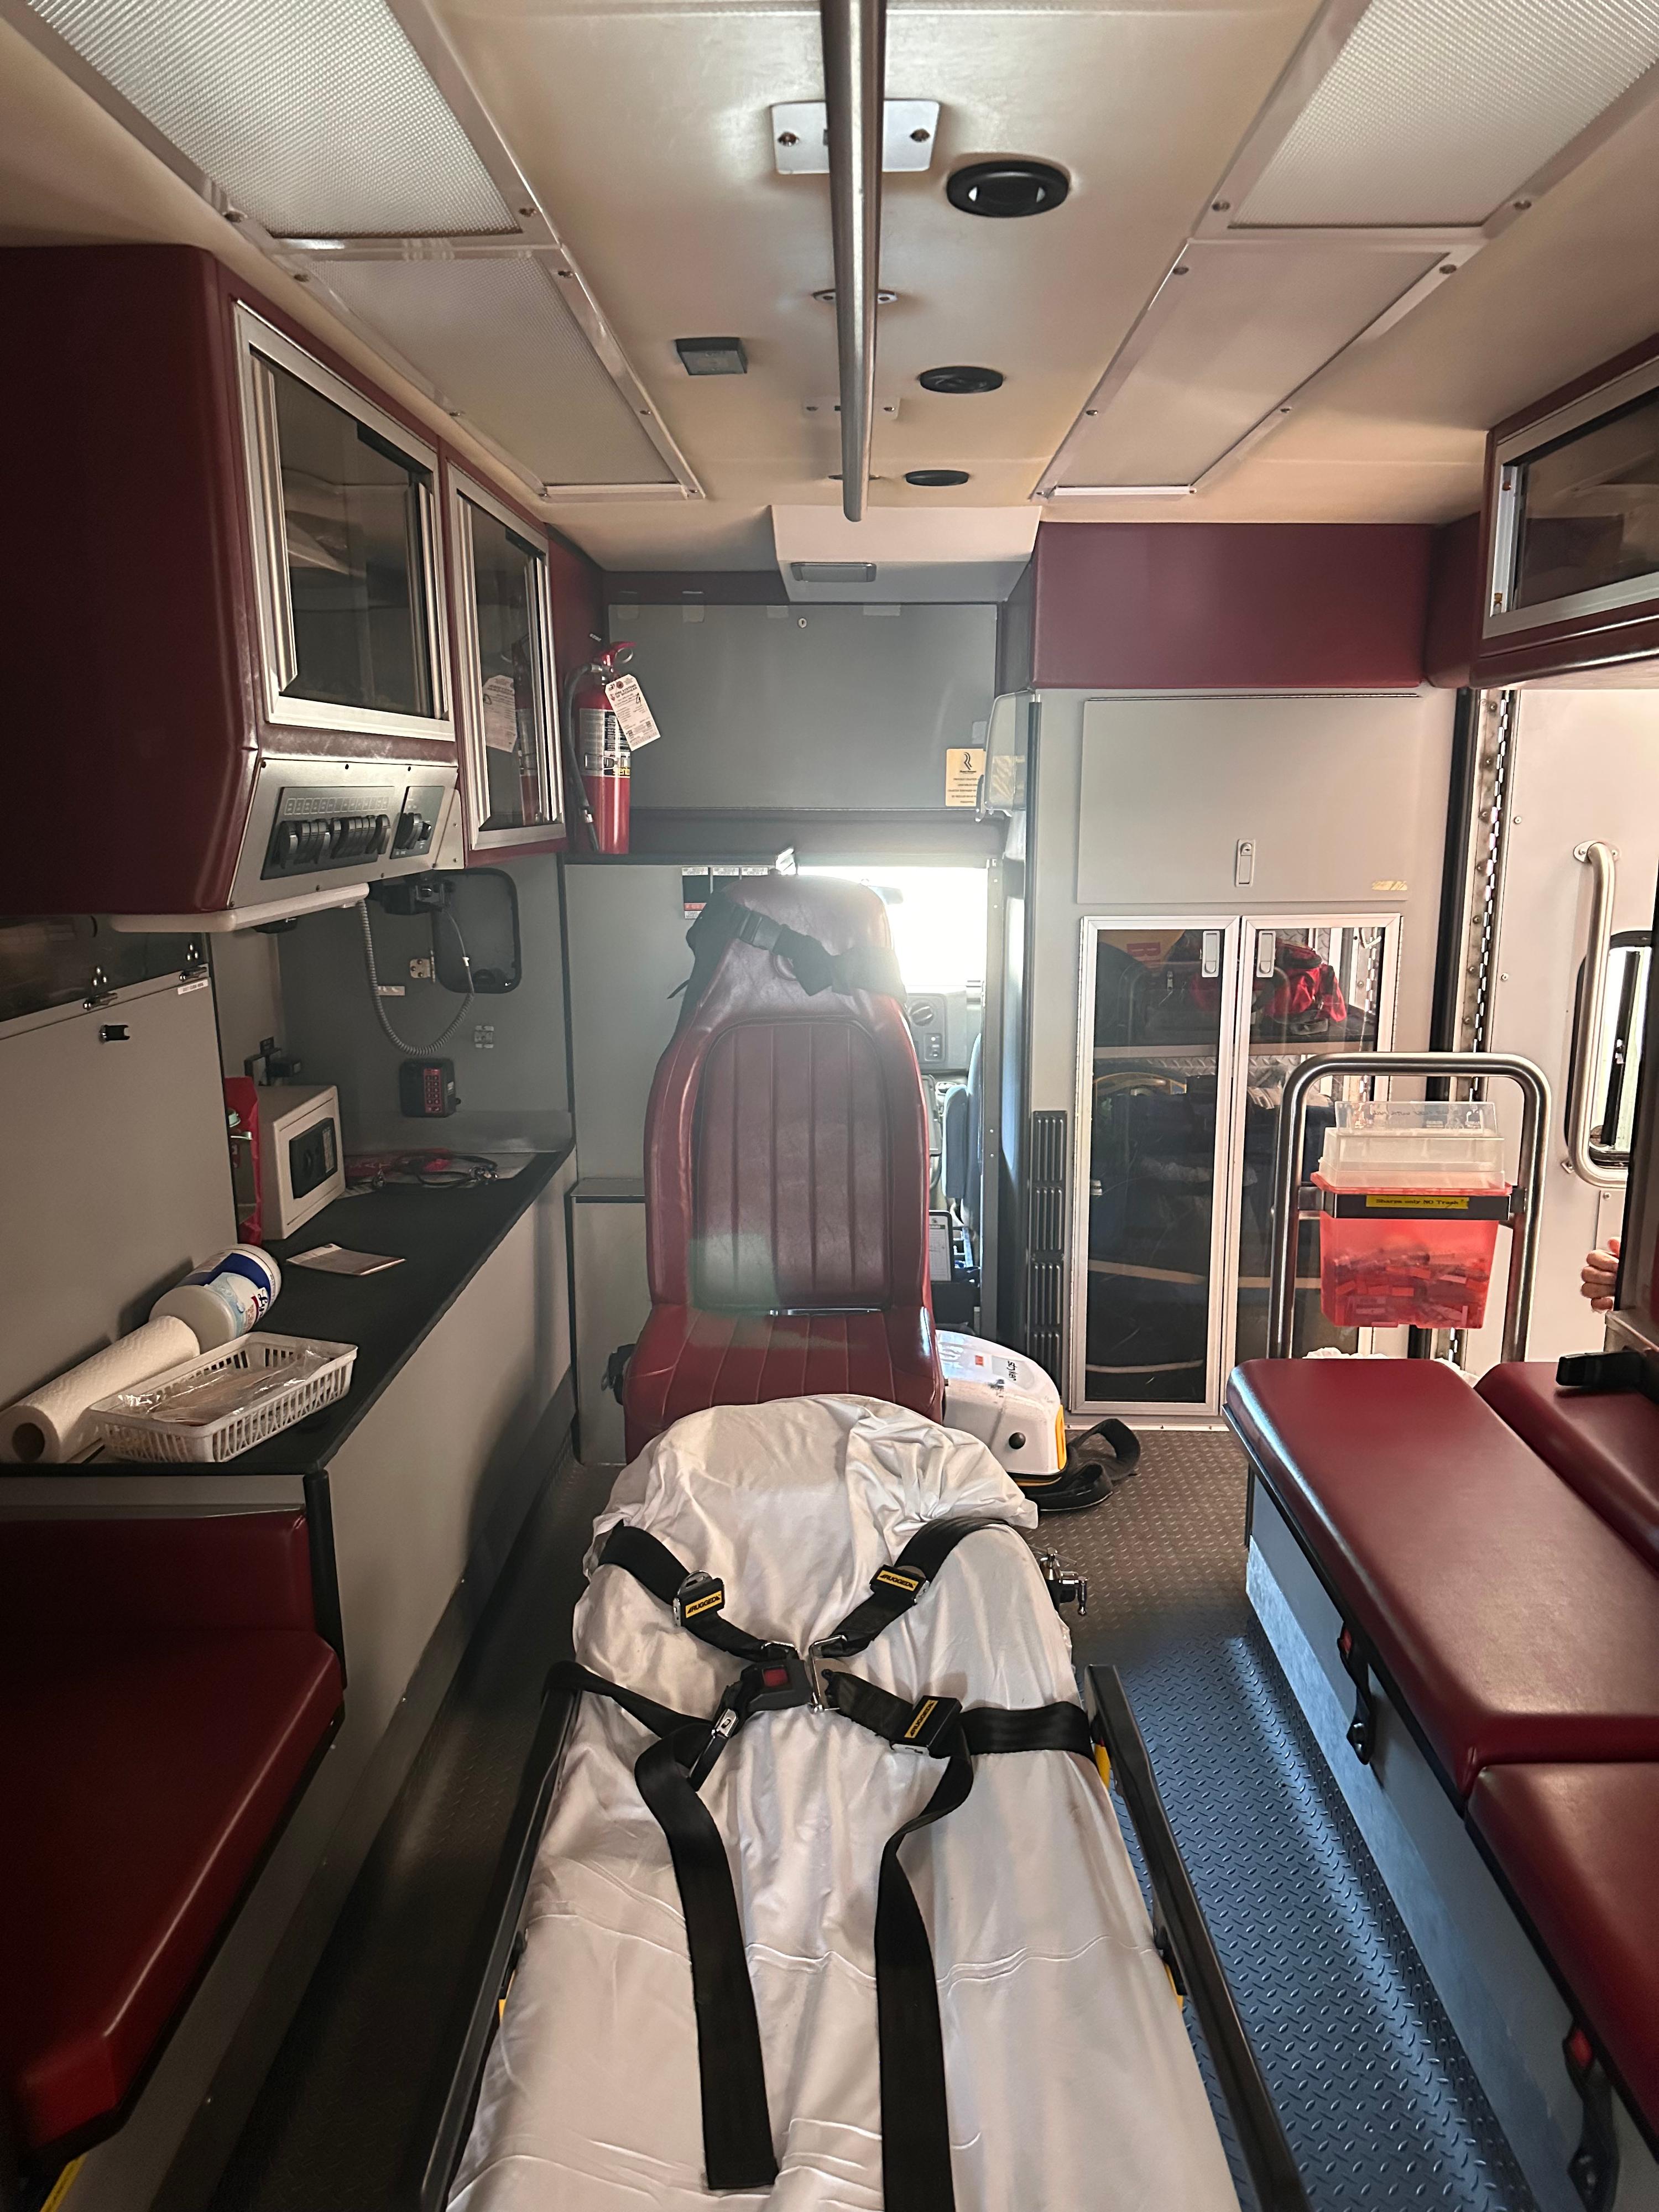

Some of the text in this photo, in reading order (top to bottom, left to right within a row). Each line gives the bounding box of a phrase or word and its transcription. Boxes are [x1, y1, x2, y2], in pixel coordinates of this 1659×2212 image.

[1006, 1360, 1018, 1381] stryker
[884, 1574, 911, 1588] RUGGED
[691, 1596, 717, 1612] RUGGED
[912, 1704, 932, 1731] RUGGED
